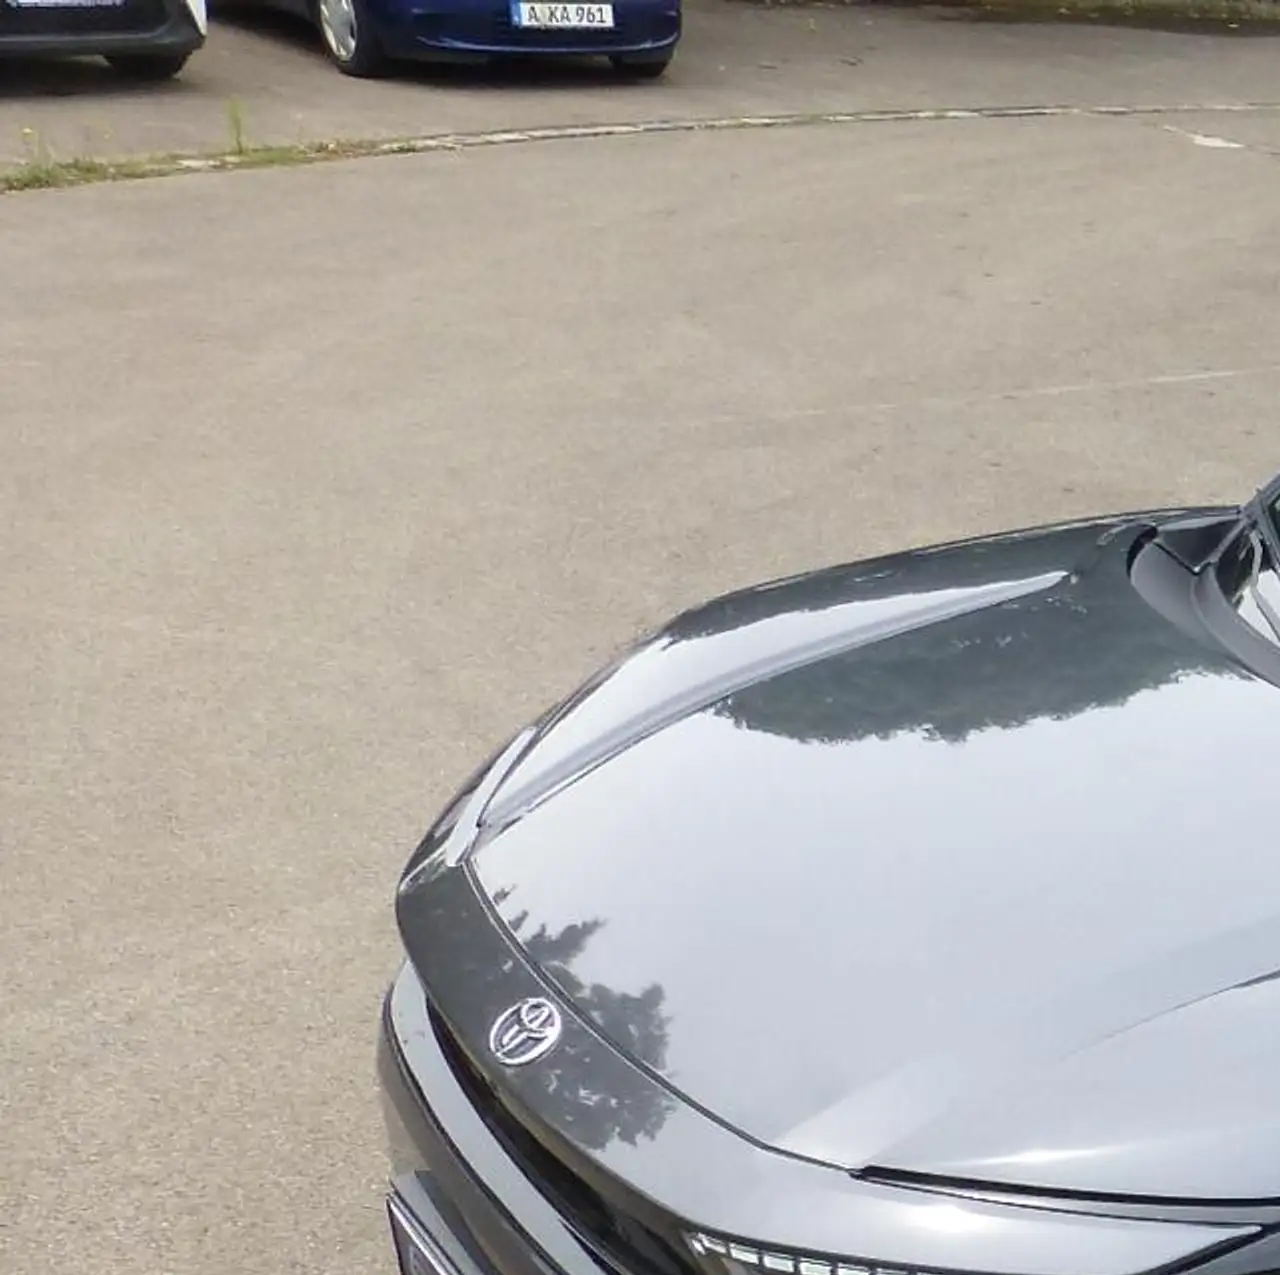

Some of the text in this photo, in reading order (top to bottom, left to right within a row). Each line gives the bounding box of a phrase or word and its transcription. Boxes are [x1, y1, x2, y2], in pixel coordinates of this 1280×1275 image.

[528, 6, 606, 23] A KA 961
